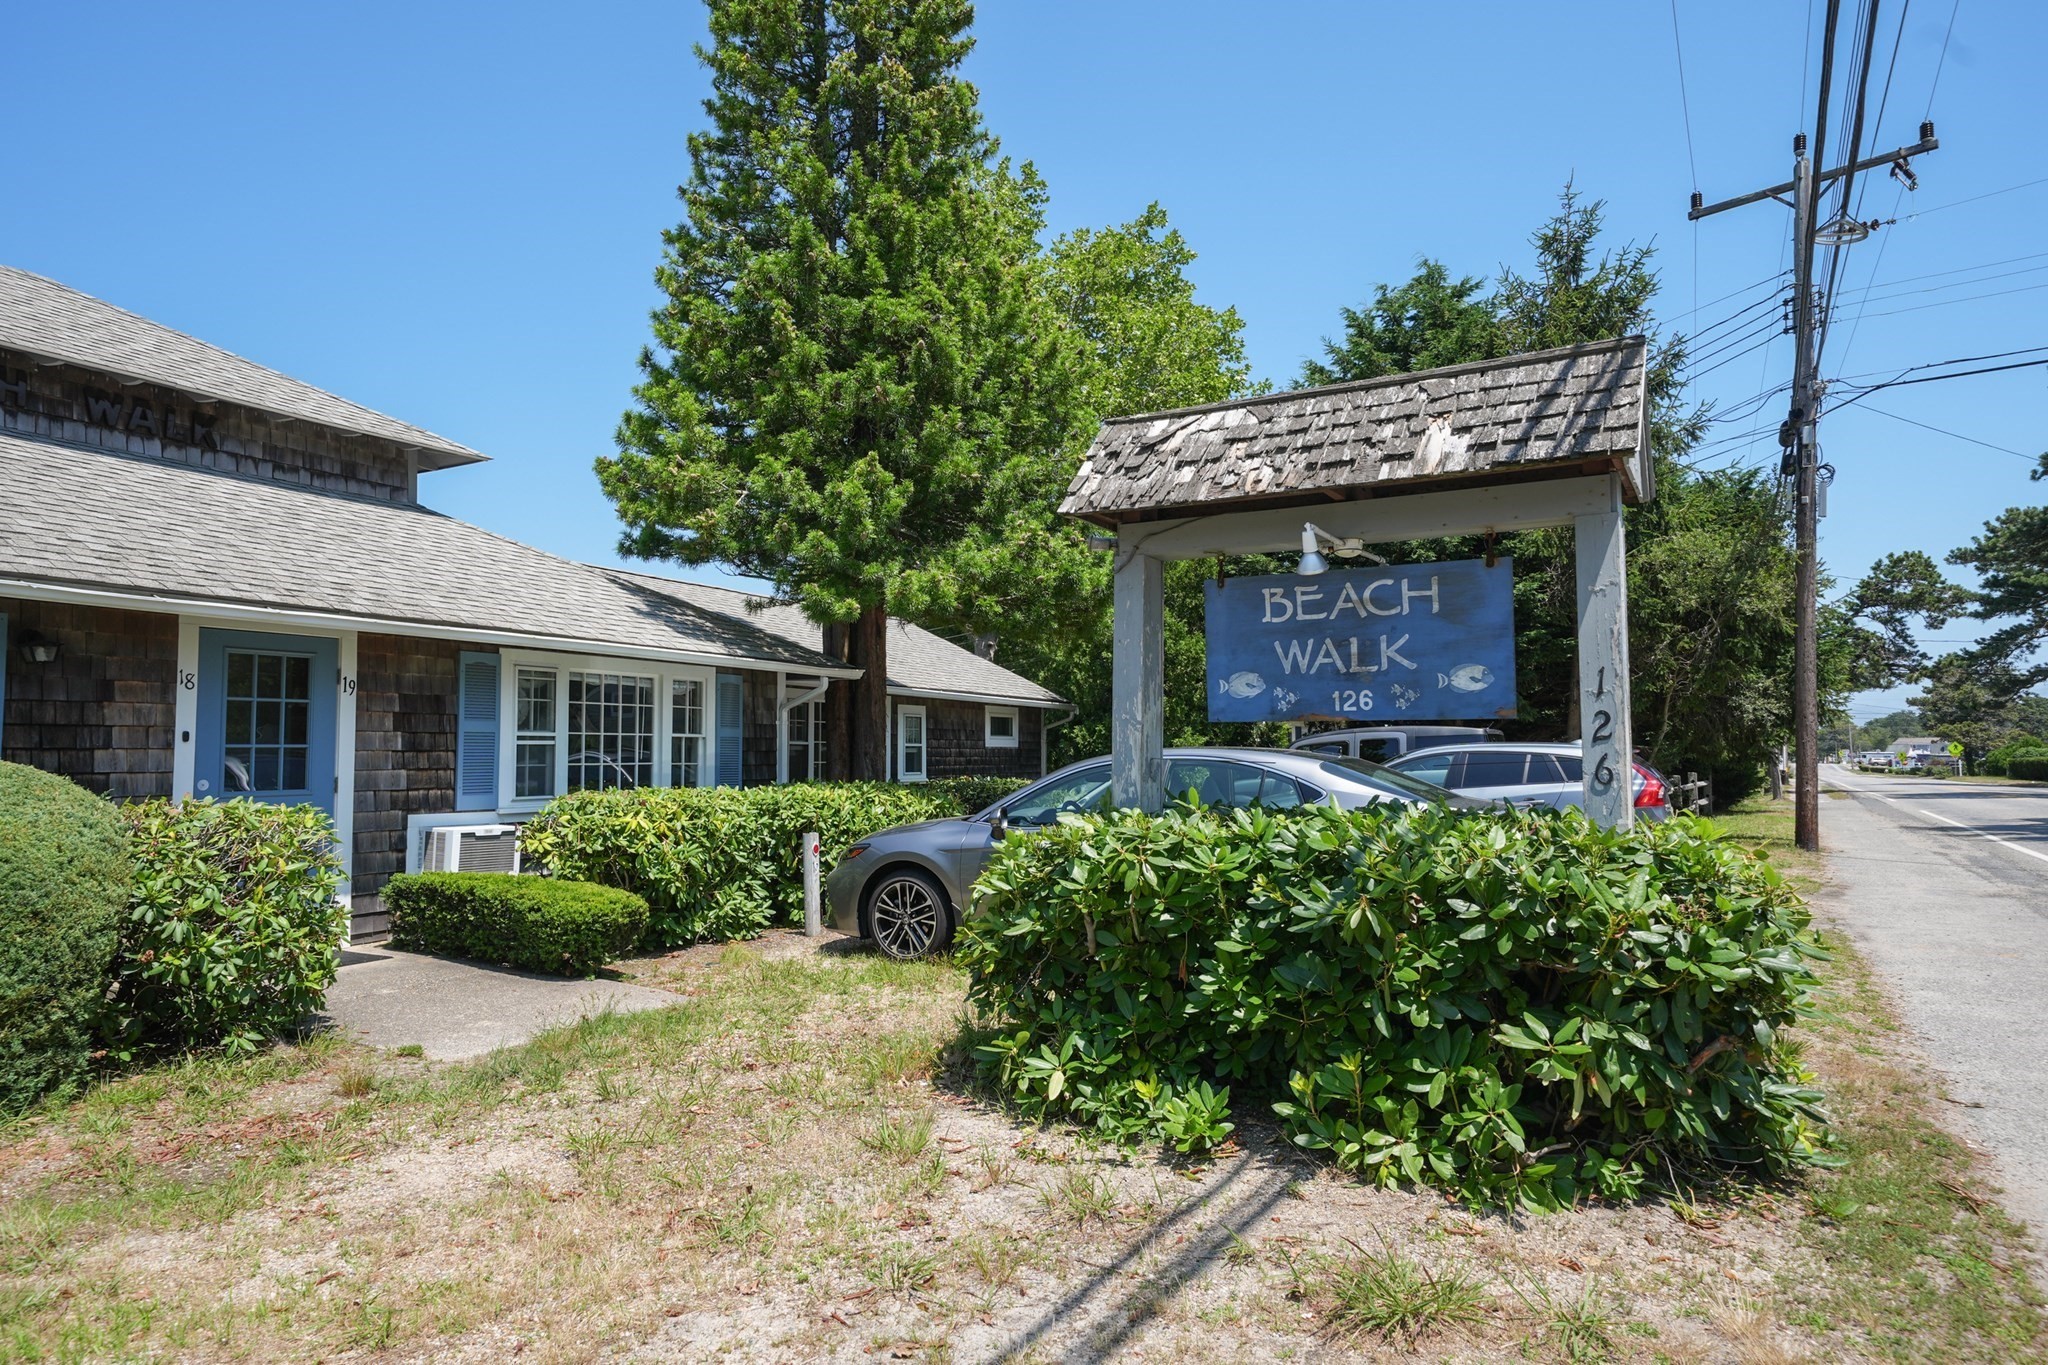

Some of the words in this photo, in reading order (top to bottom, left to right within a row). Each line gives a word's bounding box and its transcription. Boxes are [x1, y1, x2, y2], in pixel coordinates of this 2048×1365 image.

[83, 386, 218, 448] WALK
[1261, 575, 1440, 623] BEACH
[1273, 633, 1418, 675] WALK
[179, 669, 196, 690] 18
[342, 676, 356, 696] 19
[1332, 689, 1374, 712] 126
[1592, 666, 1614, 785] 126
